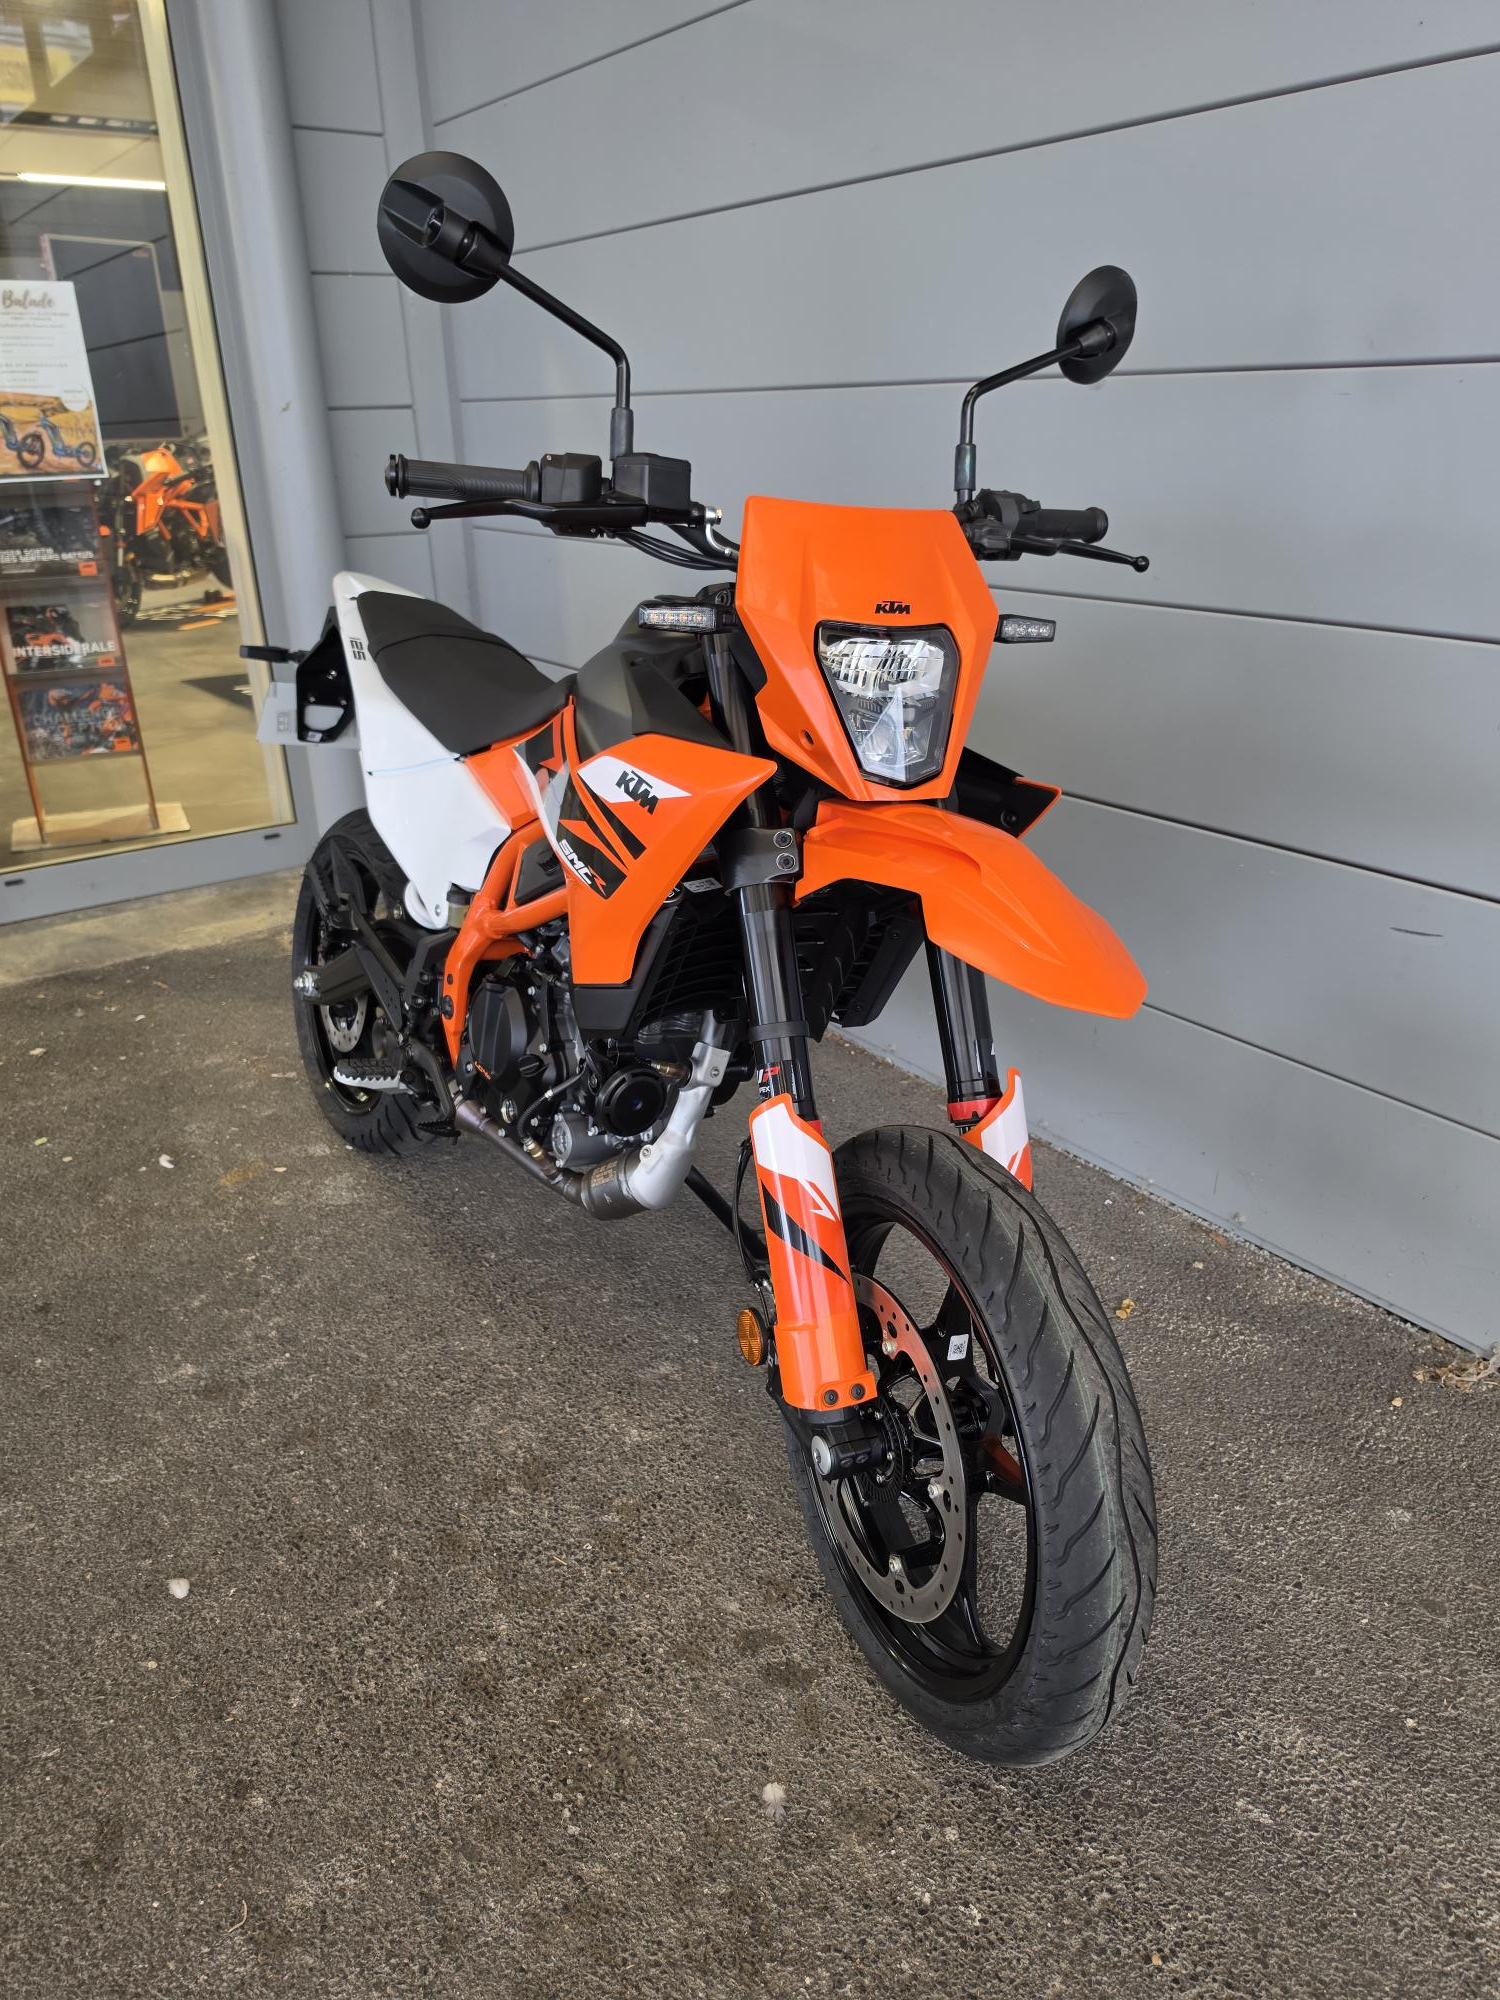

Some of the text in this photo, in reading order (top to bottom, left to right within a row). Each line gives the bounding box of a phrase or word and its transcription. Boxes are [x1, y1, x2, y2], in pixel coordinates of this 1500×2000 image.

[2, 289, 54, 309] Balade
[875, 600, 911, 615] KTM
[615, 770, 660, 815] KTM
